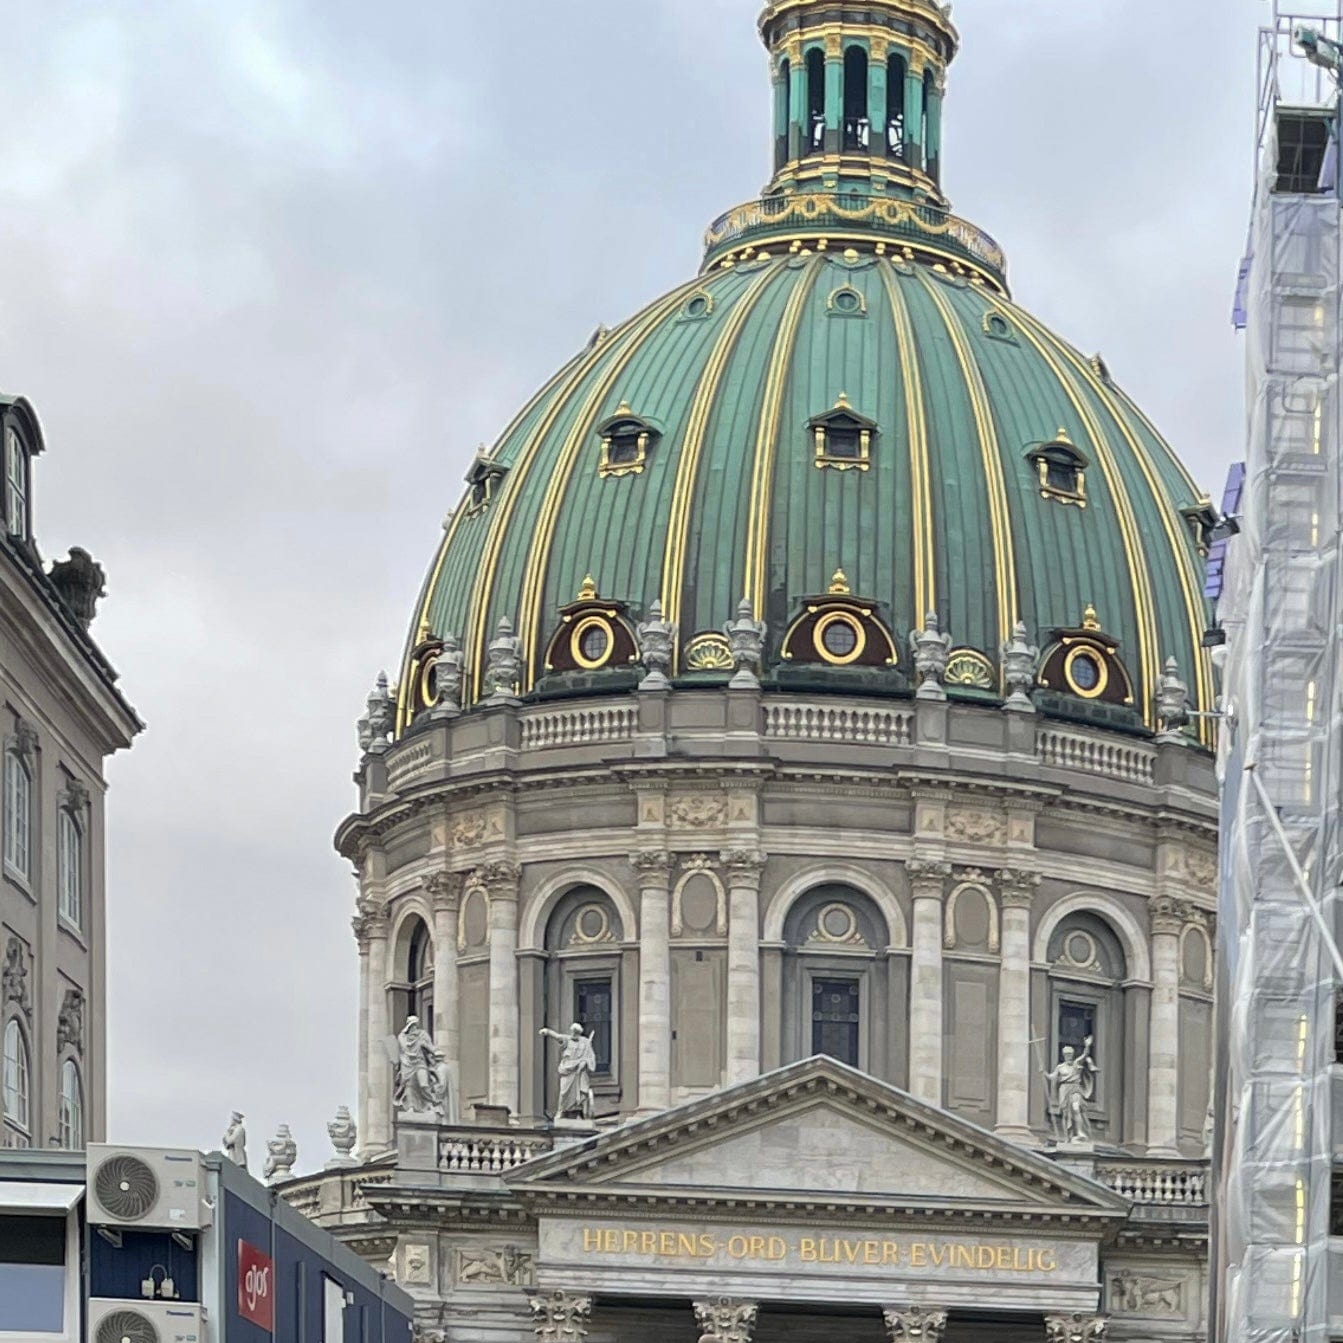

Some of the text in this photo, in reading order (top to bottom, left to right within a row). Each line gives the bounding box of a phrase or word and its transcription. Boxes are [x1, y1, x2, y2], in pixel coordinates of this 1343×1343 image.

[583, 1228, 1057, 1273] HERRENS ORD BLIVER EVINDELIG
